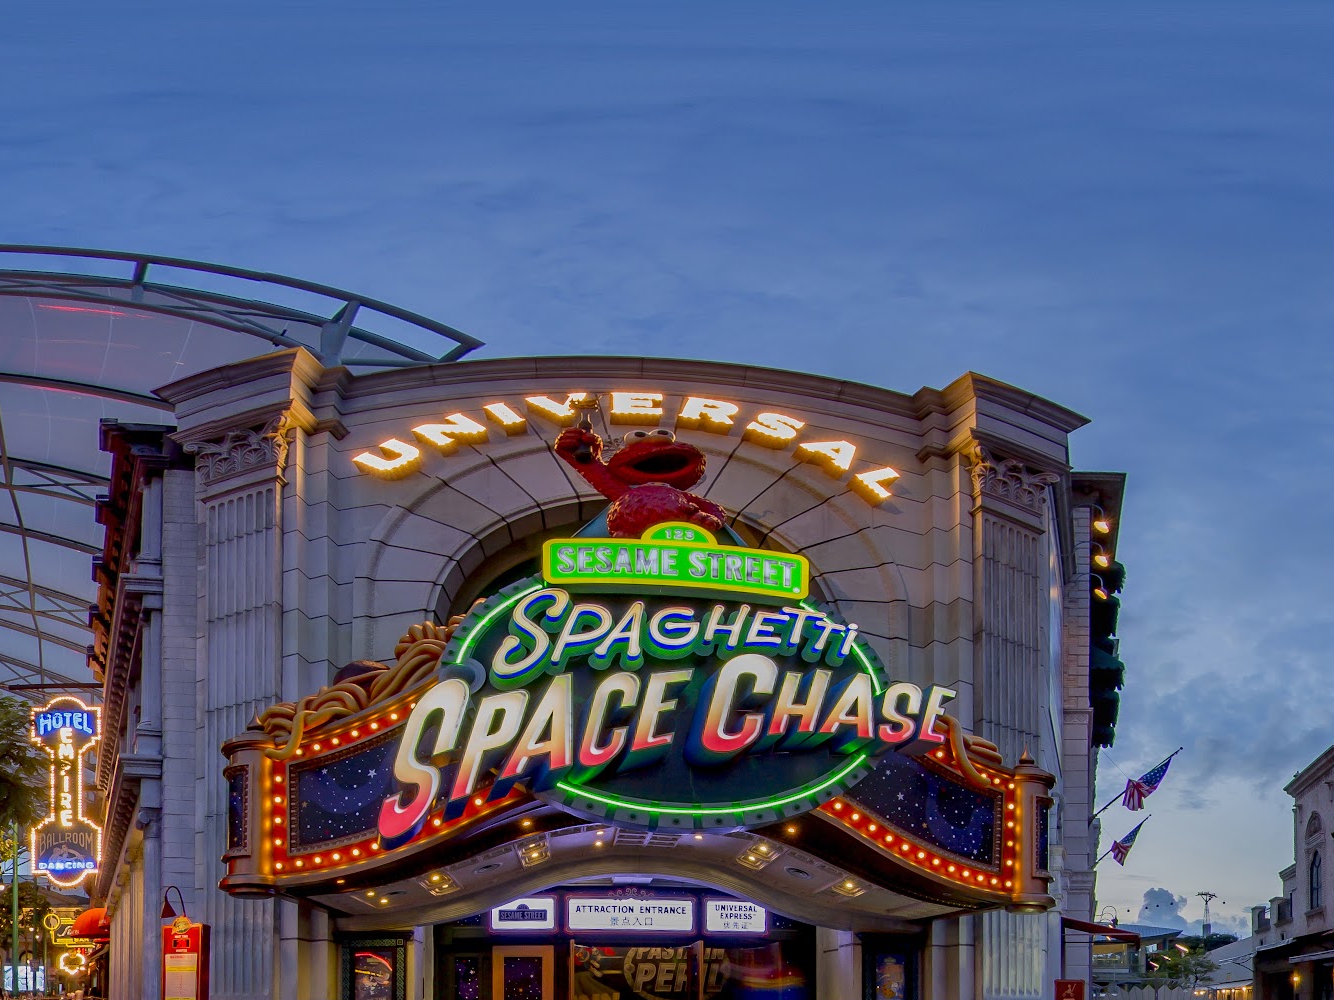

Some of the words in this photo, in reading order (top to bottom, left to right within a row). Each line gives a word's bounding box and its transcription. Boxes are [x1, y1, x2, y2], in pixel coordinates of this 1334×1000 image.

[352, 391, 901, 507] UNIVERSAL
[665, 529, 695, 540] 123
[557, 546, 679, 576] SESAME
[688, 552, 796, 588] STREET
[492, 587, 859, 679] SPAGHETTI
[39, 712, 93, 735] HOTEL
[376, 667, 694, 840] SPACE
[694, 652, 958, 755] CHASE
[58, 727, 74, 827] EMPIRE
[39, 832, 94, 857] BALLROOM
[38, 861, 95, 871] DANCING
[500, 911, 524, 920] SESAME
[524, 911, 545, 920] STREET
[575, 905, 634, 913] ATTRACTION
[639, 906, 687, 915] ENTRANCE
[715, 904, 758, 913] UNIVERSAL
[610, 916, 653, 926] 景点入口
